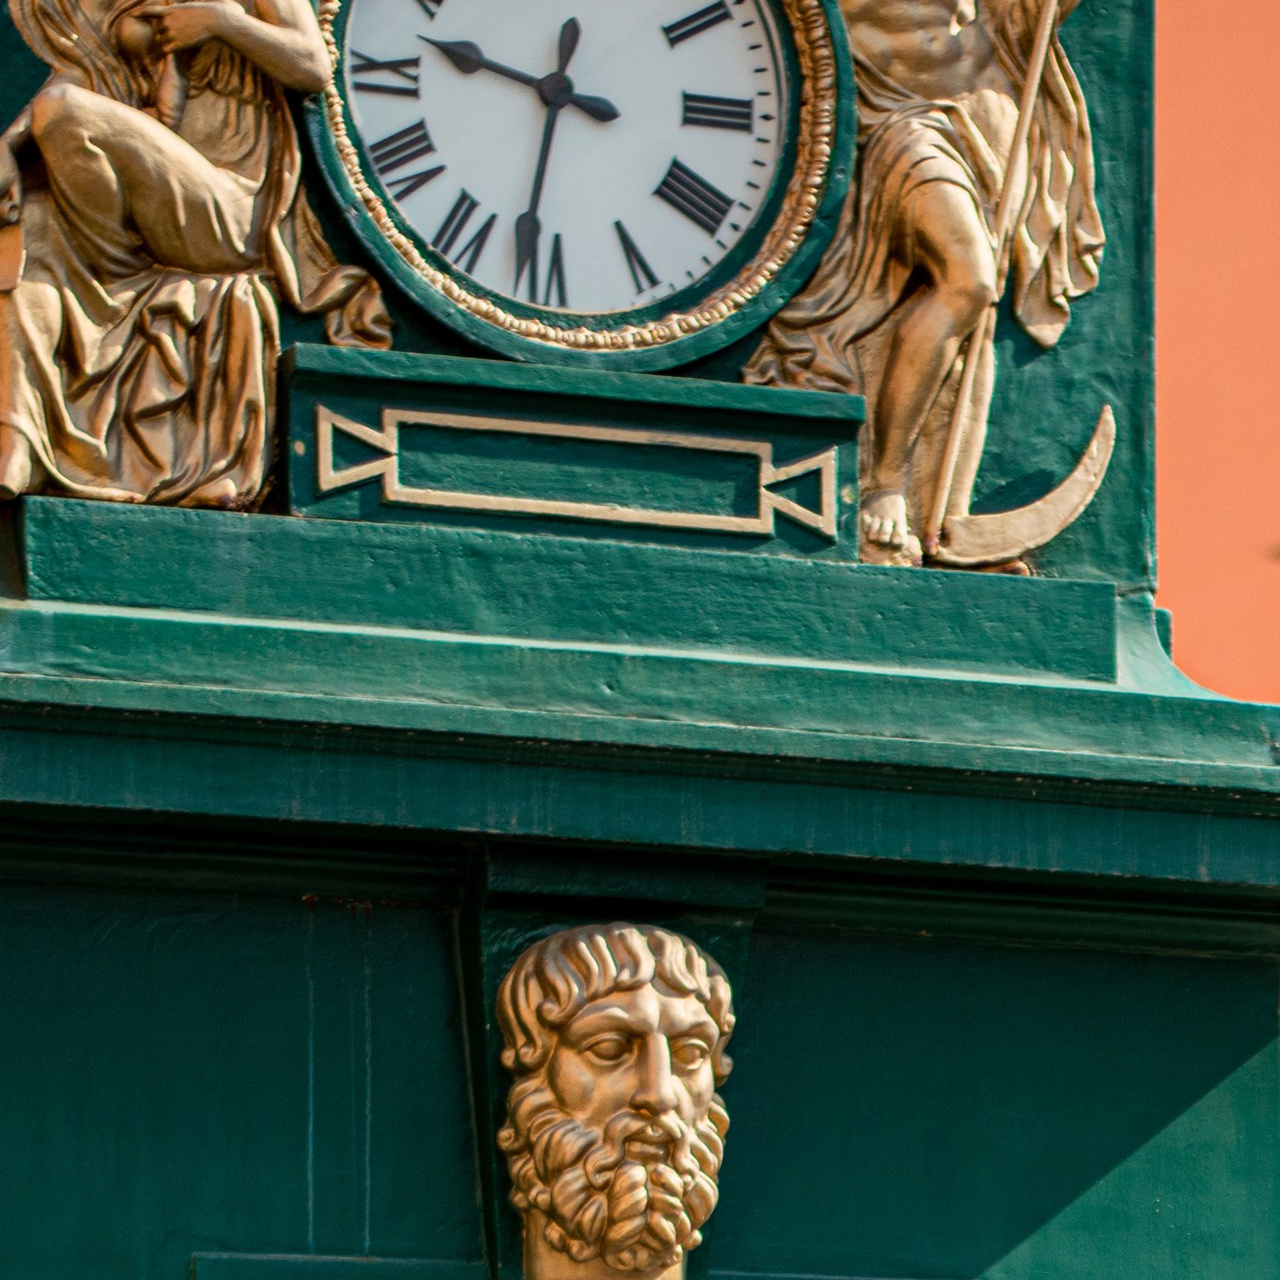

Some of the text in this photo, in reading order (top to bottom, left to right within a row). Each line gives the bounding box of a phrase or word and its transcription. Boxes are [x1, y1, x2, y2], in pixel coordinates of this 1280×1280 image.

[661, 0, 734, 49] II
[351, 49, 421, 99] IX
[681, 91, 754, 133] III
[370, 118, 447, 201] VIII
[651, 156, 736, 237] IIII
[432, 187, 499, 274] VII
[614, 219, 663, 295] V
